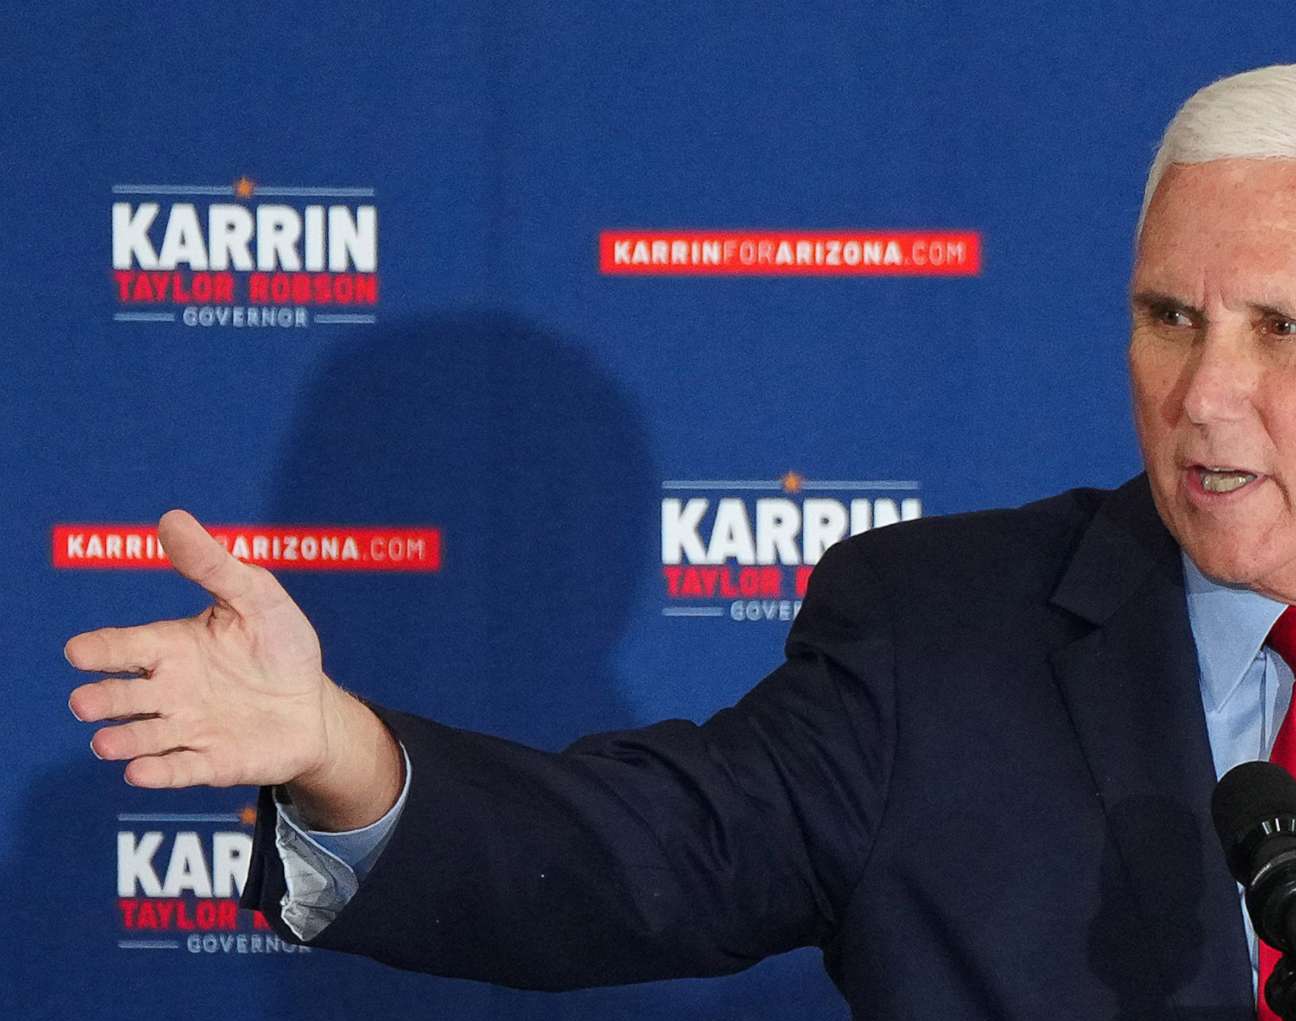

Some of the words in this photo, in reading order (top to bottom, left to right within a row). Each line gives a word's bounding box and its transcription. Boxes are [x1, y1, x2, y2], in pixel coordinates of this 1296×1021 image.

[112, 203, 377, 272] KARRIN
[613, 239, 967, 266] KARRINFORARIZONA.COM
[115, 272, 234, 303] TAYLOR
[249, 273, 378, 304] ROBSON
[183, 306, 308, 327] GOVERNOR
[664, 565, 782, 598] TAYLOR
[117, 831, 252, 897] KAR
[119, 900, 237, 930] TAYLOR
